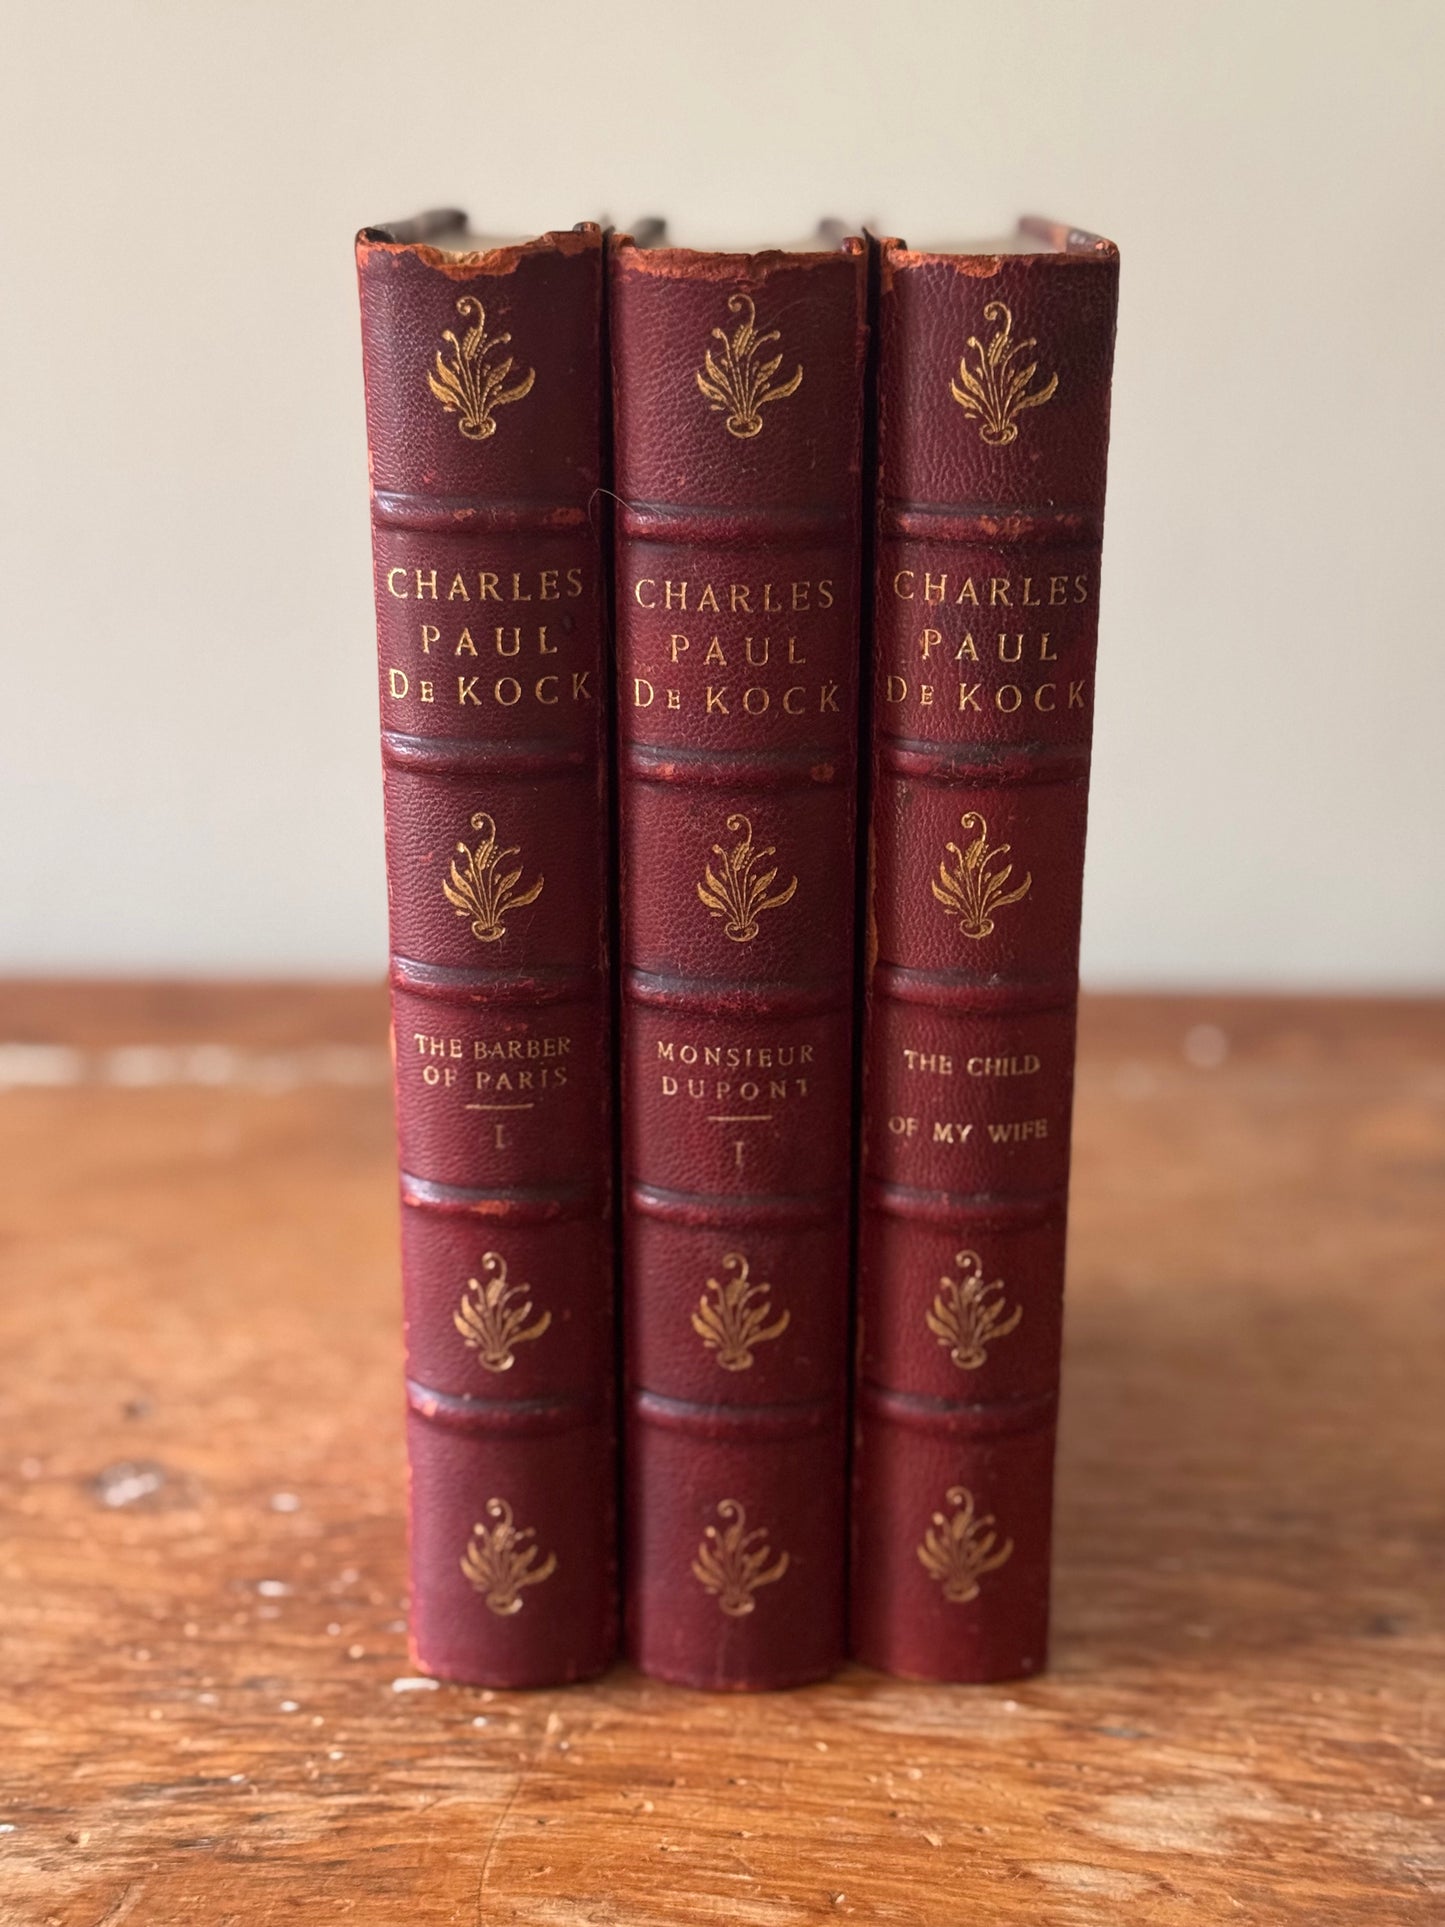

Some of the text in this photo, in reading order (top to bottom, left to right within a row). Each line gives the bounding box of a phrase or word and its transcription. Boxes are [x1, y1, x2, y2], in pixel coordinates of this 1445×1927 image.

[387, 567, 584, 602] CHARLES
[635, 579, 835, 613] CHARLES
[893, 570, 1089, 608] CHARLES
[421, 624, 559, 657] PAUL
[670, 634, 807, 667] PAUL
[920, 628, 1059, 663] PAUL
[457, 671, 592, 706] KOCK
[705, 684, 840, 715] KOCK
[957, 679, 1086, 713] KOCK
[413, 1033, 572, 1060] THE BARBER
[657, 1040, 814, 1068] MONSIEUR
[903, 1049, 1041, 1077] THE CHILD
[422, 1065, 568, 1091] OF PARIS
[661, 1075, 808, 1100] DUPONT
[888, 1115, 1048, 1144] OF MY WIFE
